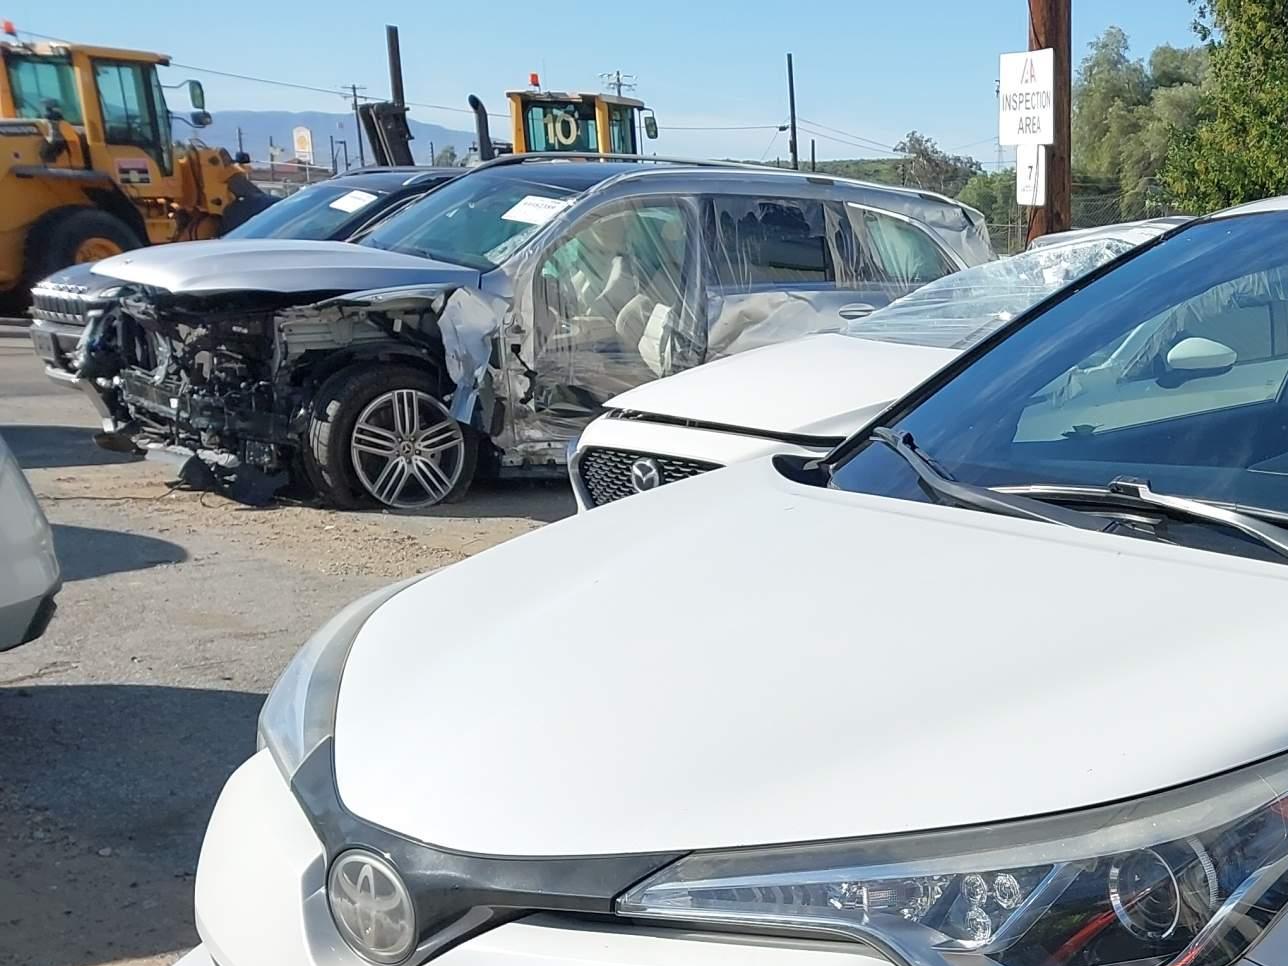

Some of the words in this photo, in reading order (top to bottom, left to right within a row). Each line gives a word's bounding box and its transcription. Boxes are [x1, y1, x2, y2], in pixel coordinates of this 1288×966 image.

[1002, 90, 1051, 112] INSPECTION
[543, 113, 577, 145] 10
[1017, 116, 1042, 135] AREA
[1027, 165, 1034, 181] 7
